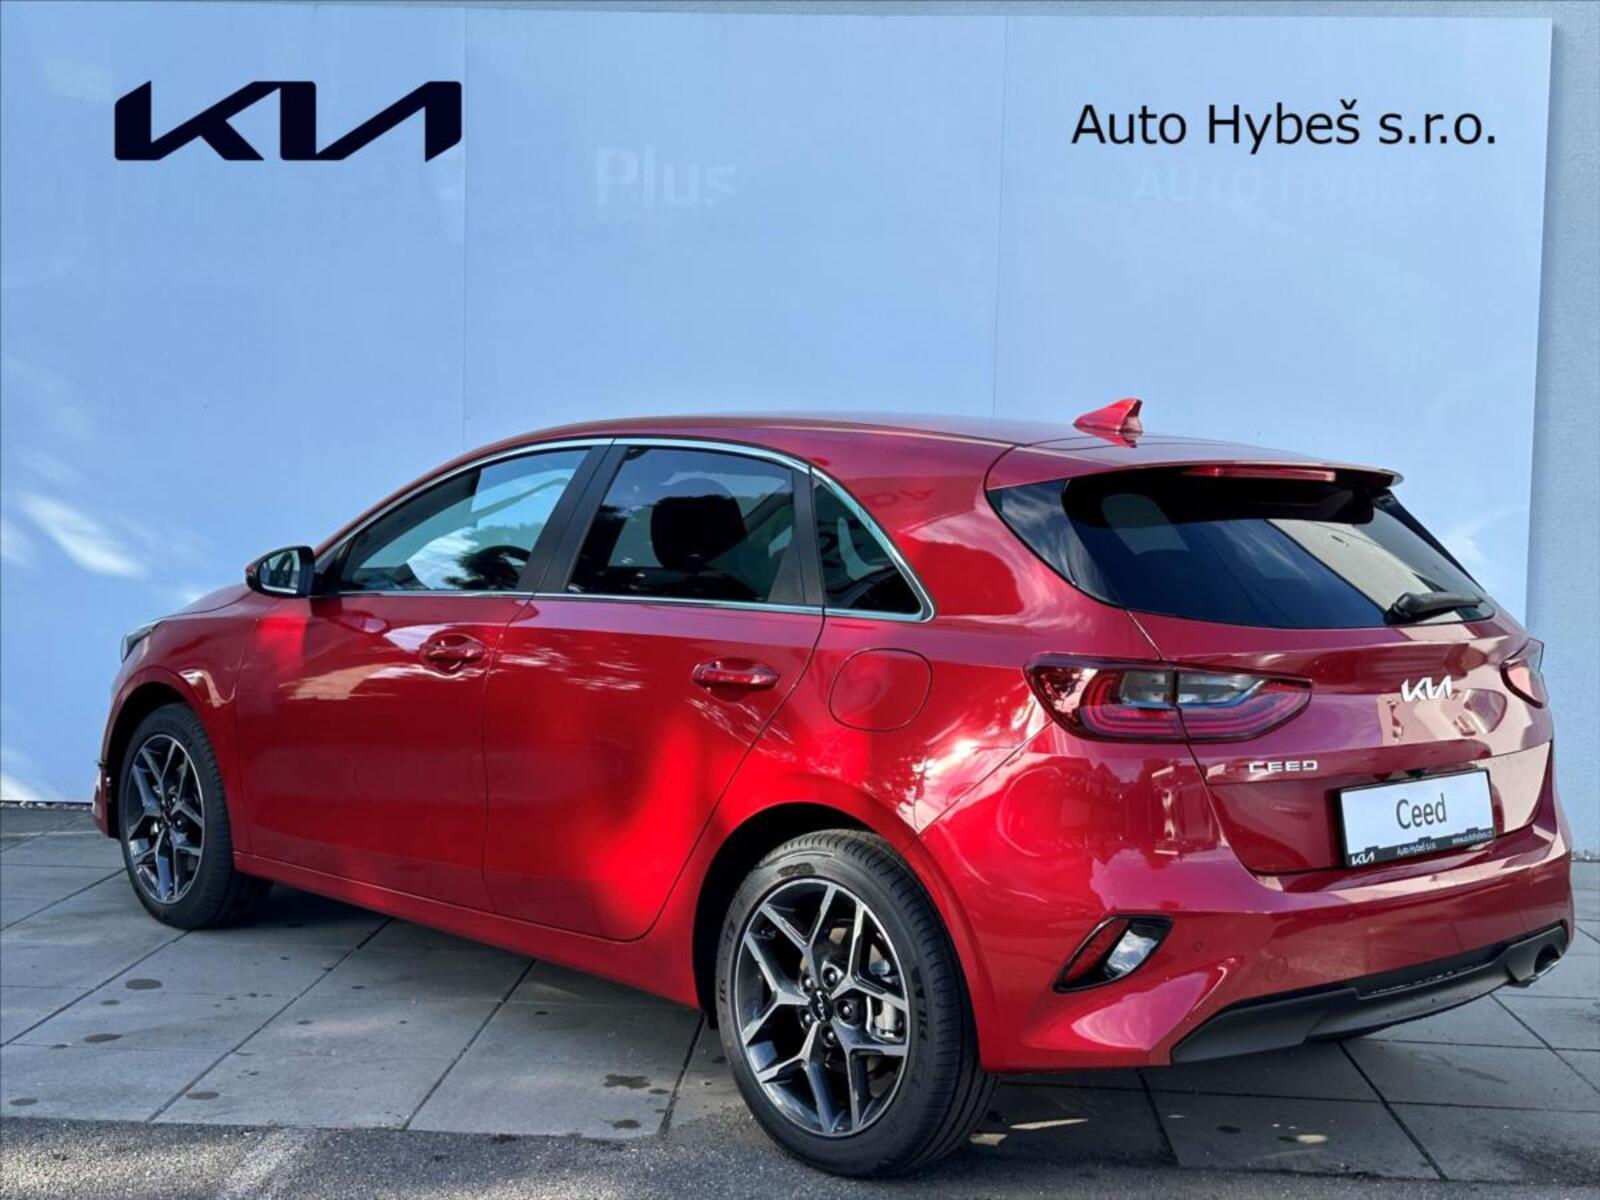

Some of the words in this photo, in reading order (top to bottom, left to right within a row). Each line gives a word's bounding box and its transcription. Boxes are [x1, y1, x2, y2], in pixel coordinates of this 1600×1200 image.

[595, 142, 737, 208] Plus
[1400, 675, 1452, 702] KIA
[1248, 760, 1318, 773] CEED
[1396, 792, 1447, 830] Ceed
